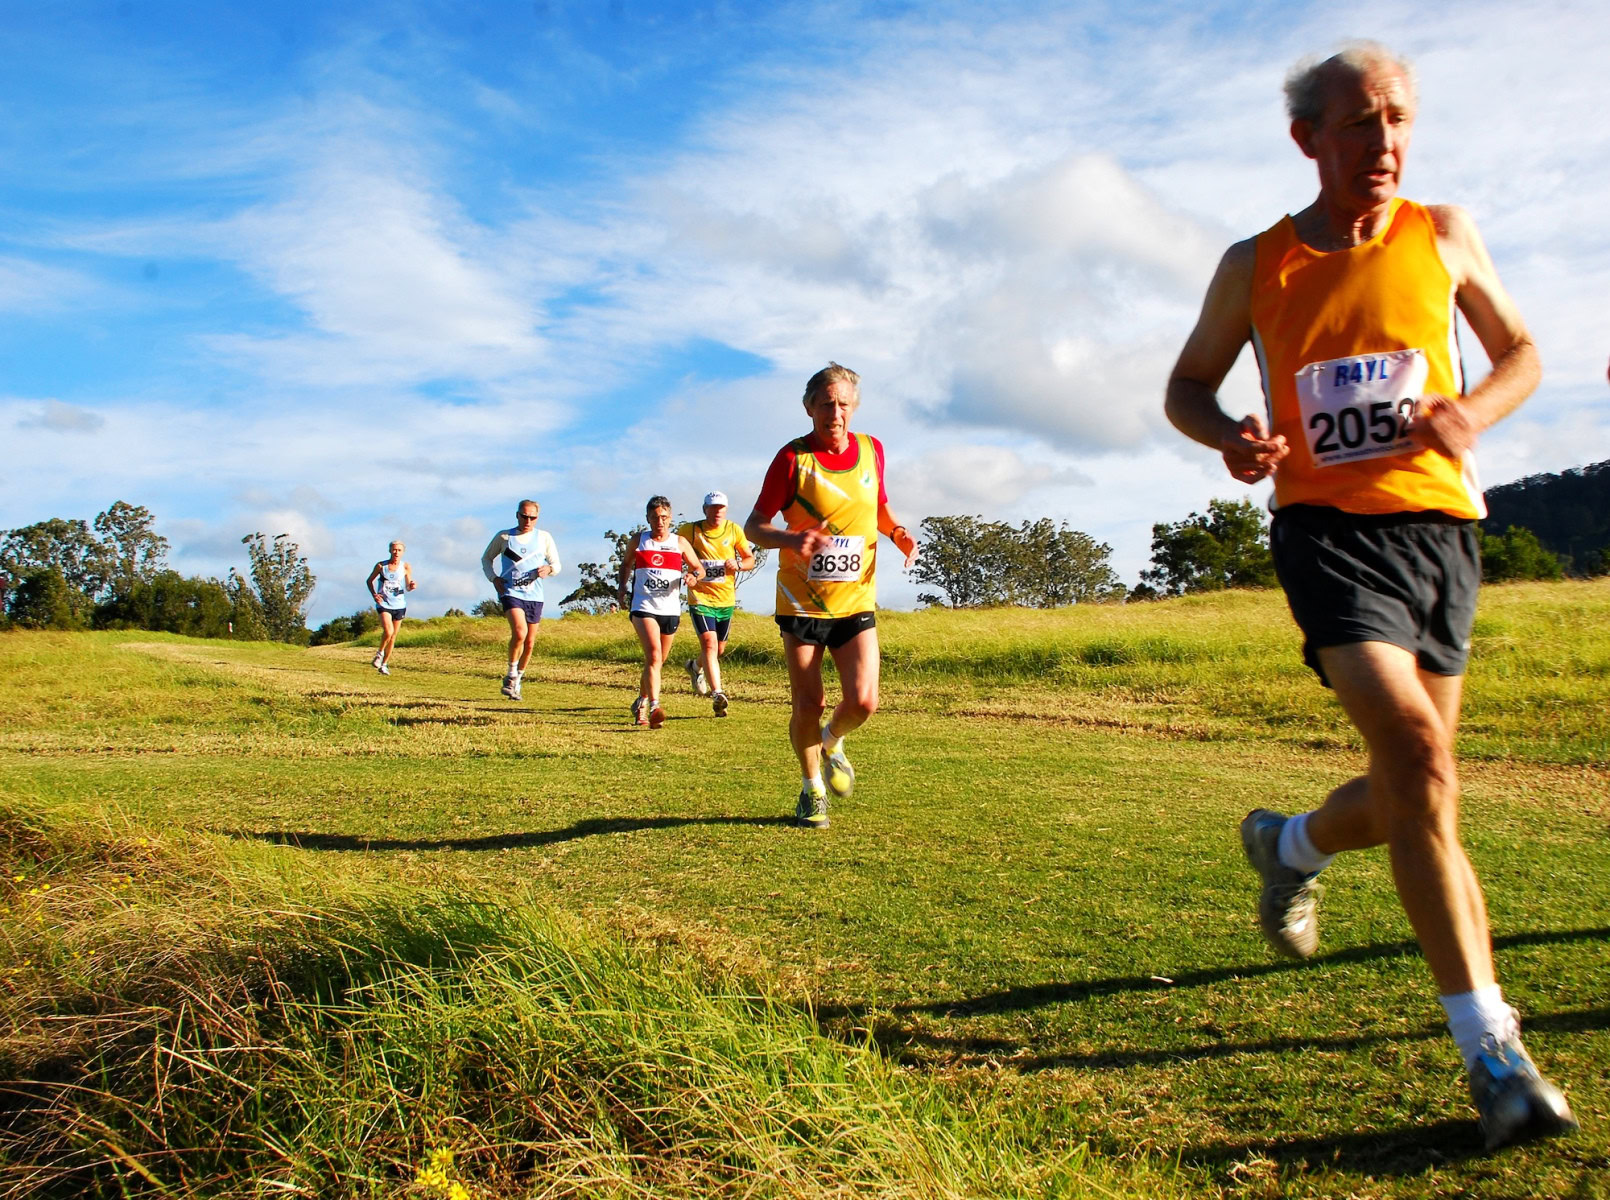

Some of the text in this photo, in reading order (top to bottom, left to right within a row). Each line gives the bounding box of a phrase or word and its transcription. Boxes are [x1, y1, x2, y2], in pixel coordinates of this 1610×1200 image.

[1333, 360, 1388, 387] R4YL
[1309, 397, 1415, 454] 2052
[828, 537, 850, 548] 4YL
[812, 554, 861, 573] 3638
[706, 567, 725, 578] 636
[643, 578, 670, 589] 4389
